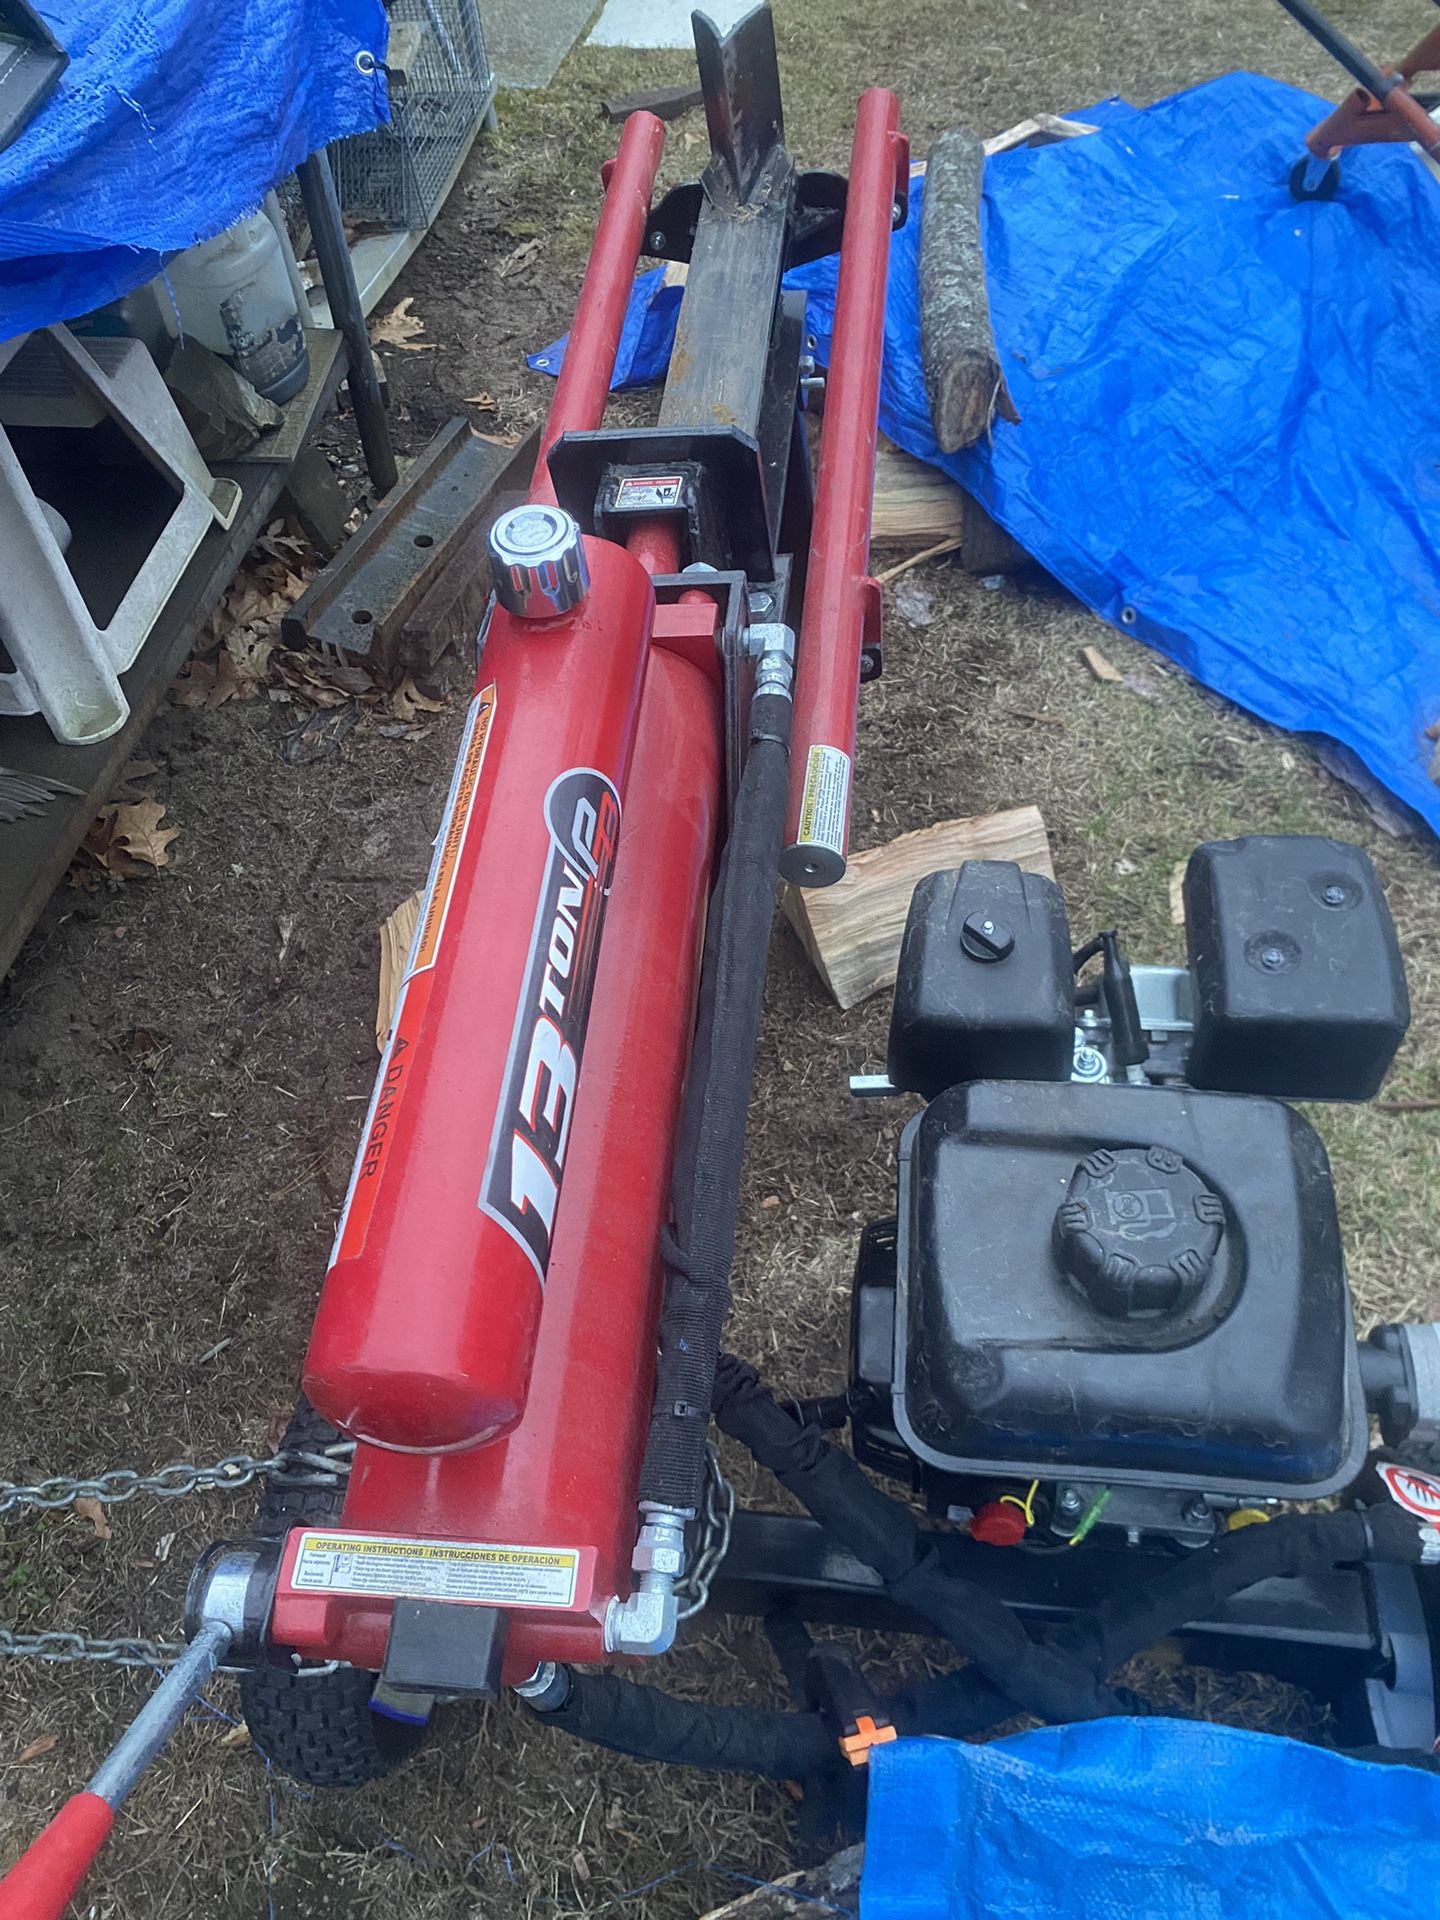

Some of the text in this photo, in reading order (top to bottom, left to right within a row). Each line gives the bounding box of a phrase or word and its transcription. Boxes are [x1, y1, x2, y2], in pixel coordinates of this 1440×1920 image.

[480, 716, 488, 730] NO
[461, 790, 471, 808] OIL
[803, 803, 814, 836] CAUTION
[511, 861, 583, 1237] 13 TON
[360, 1064, 403, 1181] DANGER
[316, 1542, 361, 1551] OPERATING
[363, 1545, 423, 1556] INSTRUCTIONS
[429, 1549, 496, 1561] INSTRUCCIONES
[498, 1554, 509, 1562] DE
